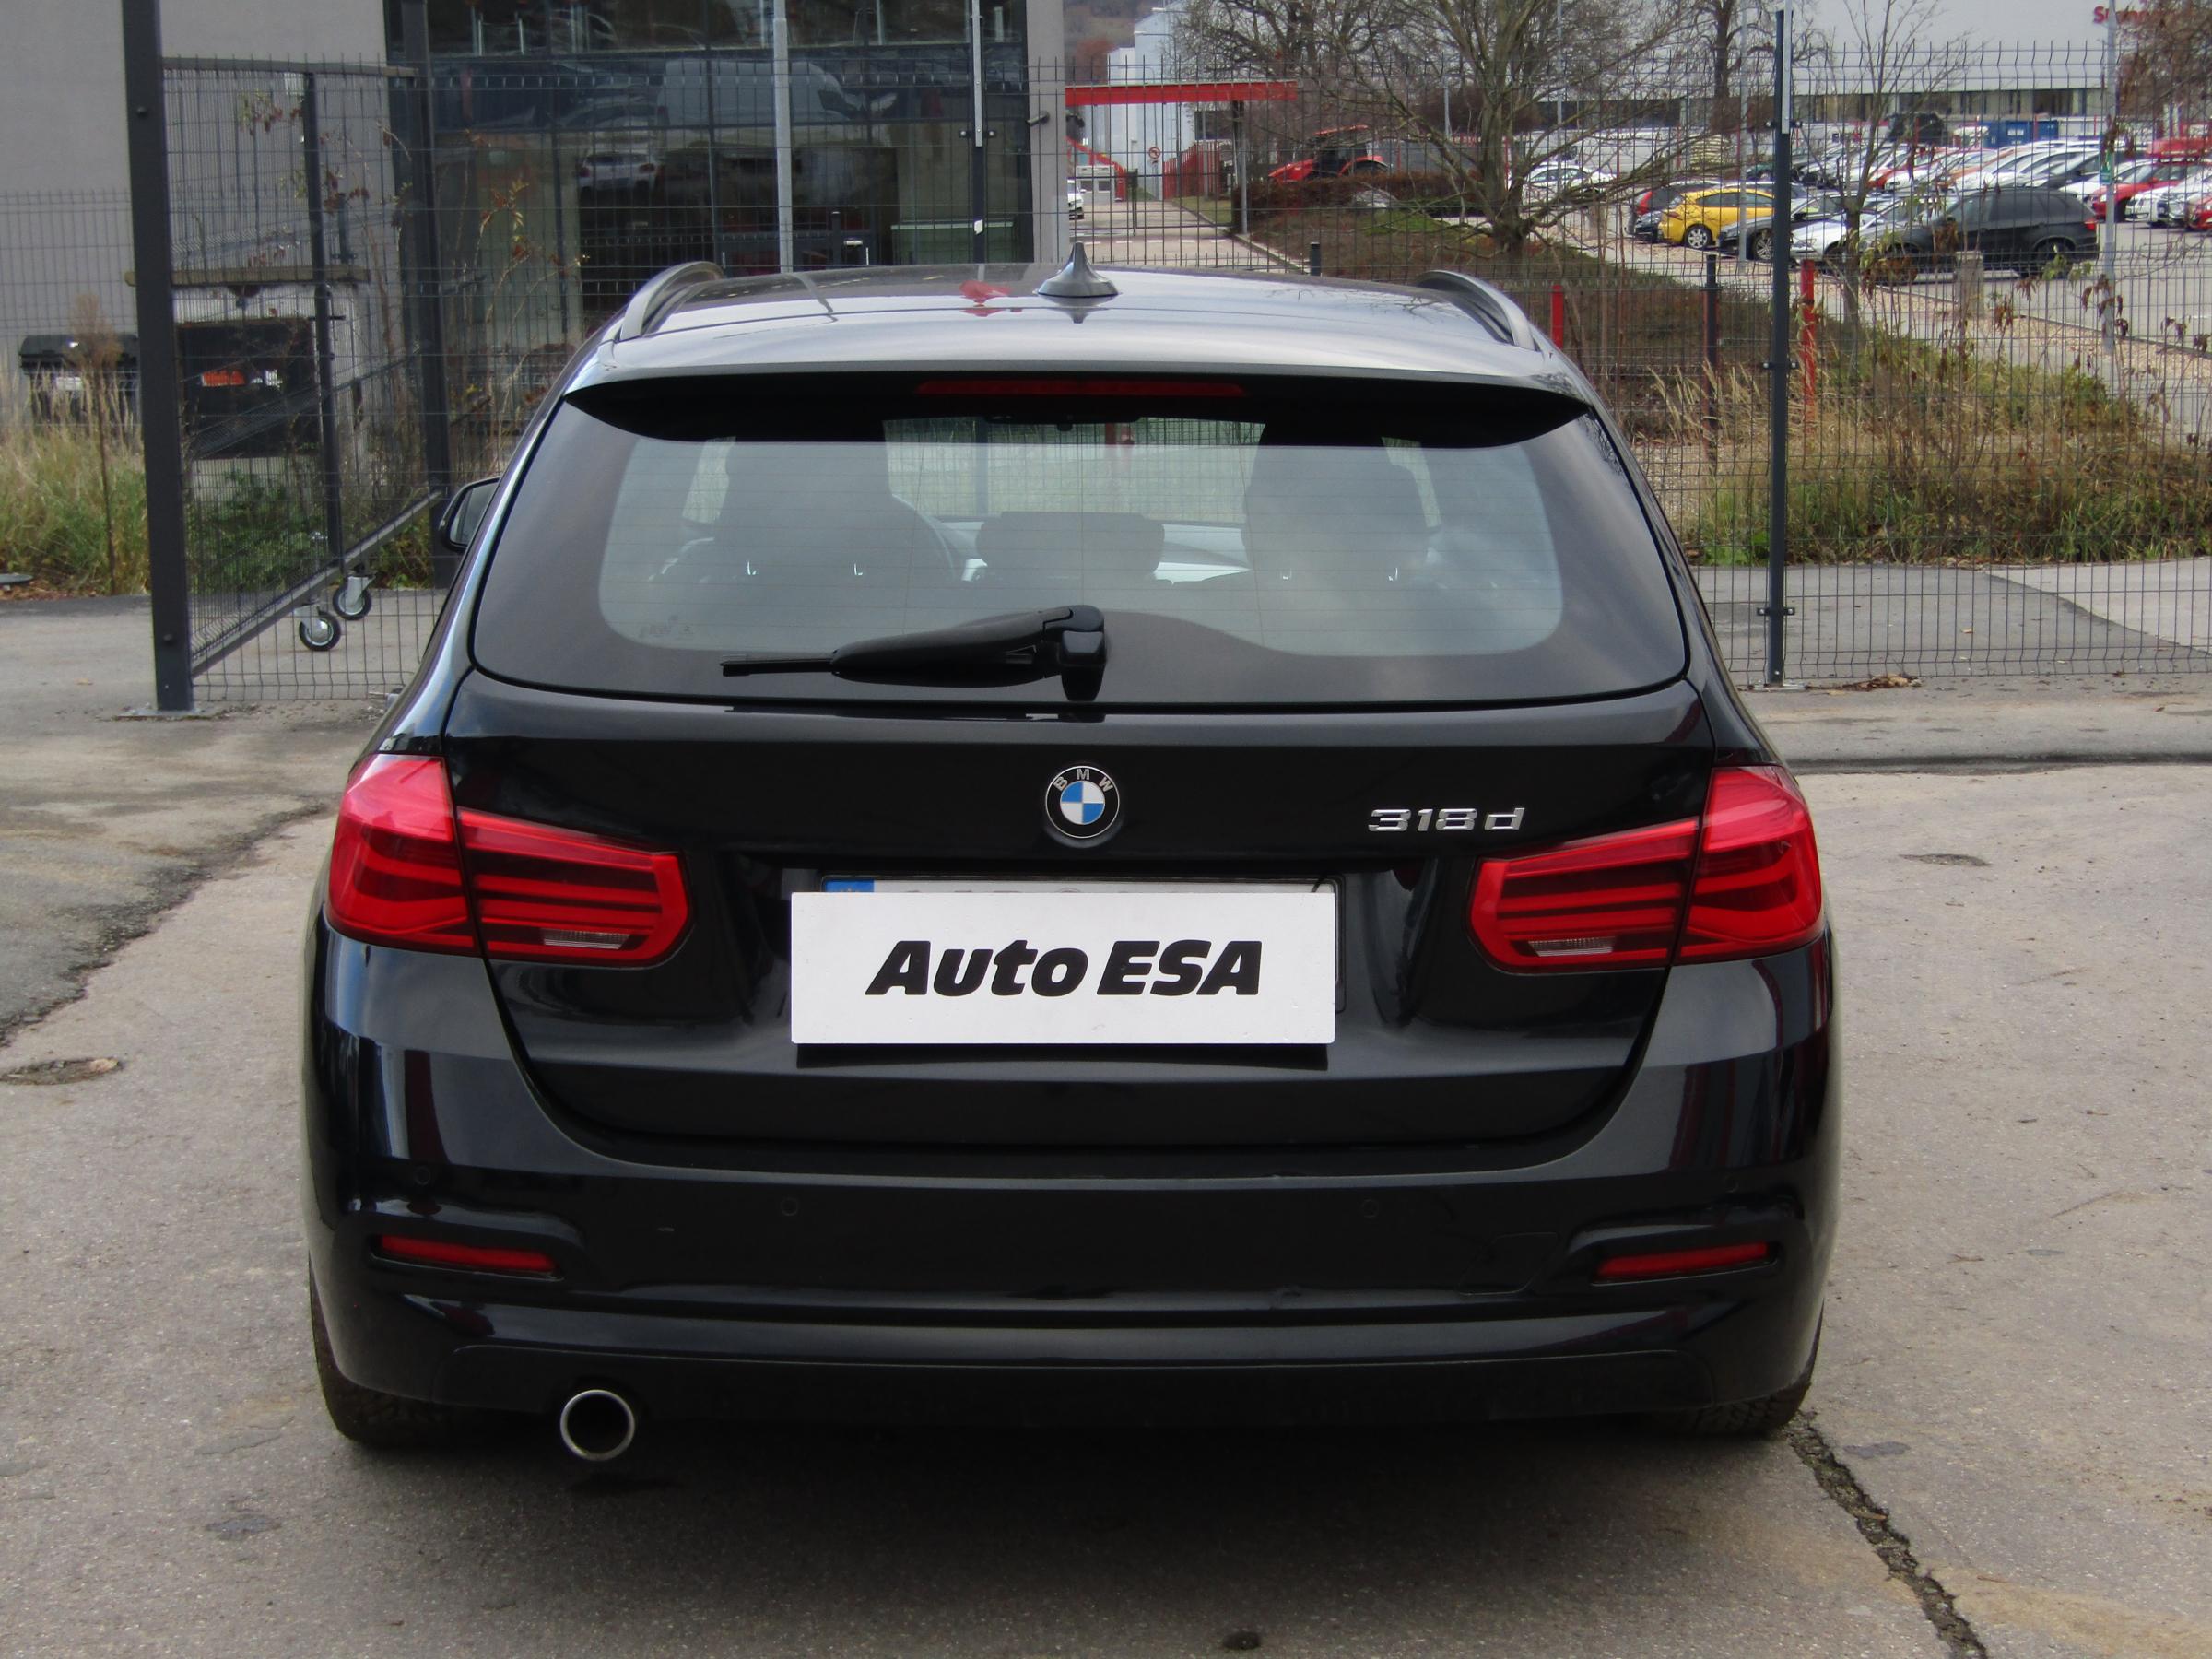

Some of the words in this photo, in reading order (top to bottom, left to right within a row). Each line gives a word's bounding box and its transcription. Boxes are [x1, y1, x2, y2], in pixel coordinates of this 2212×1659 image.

[1053, 768, 1113, 792] BMW
[865, 939, 1088, 997] Auto
[1097, 939, 1263, 996] ESA
